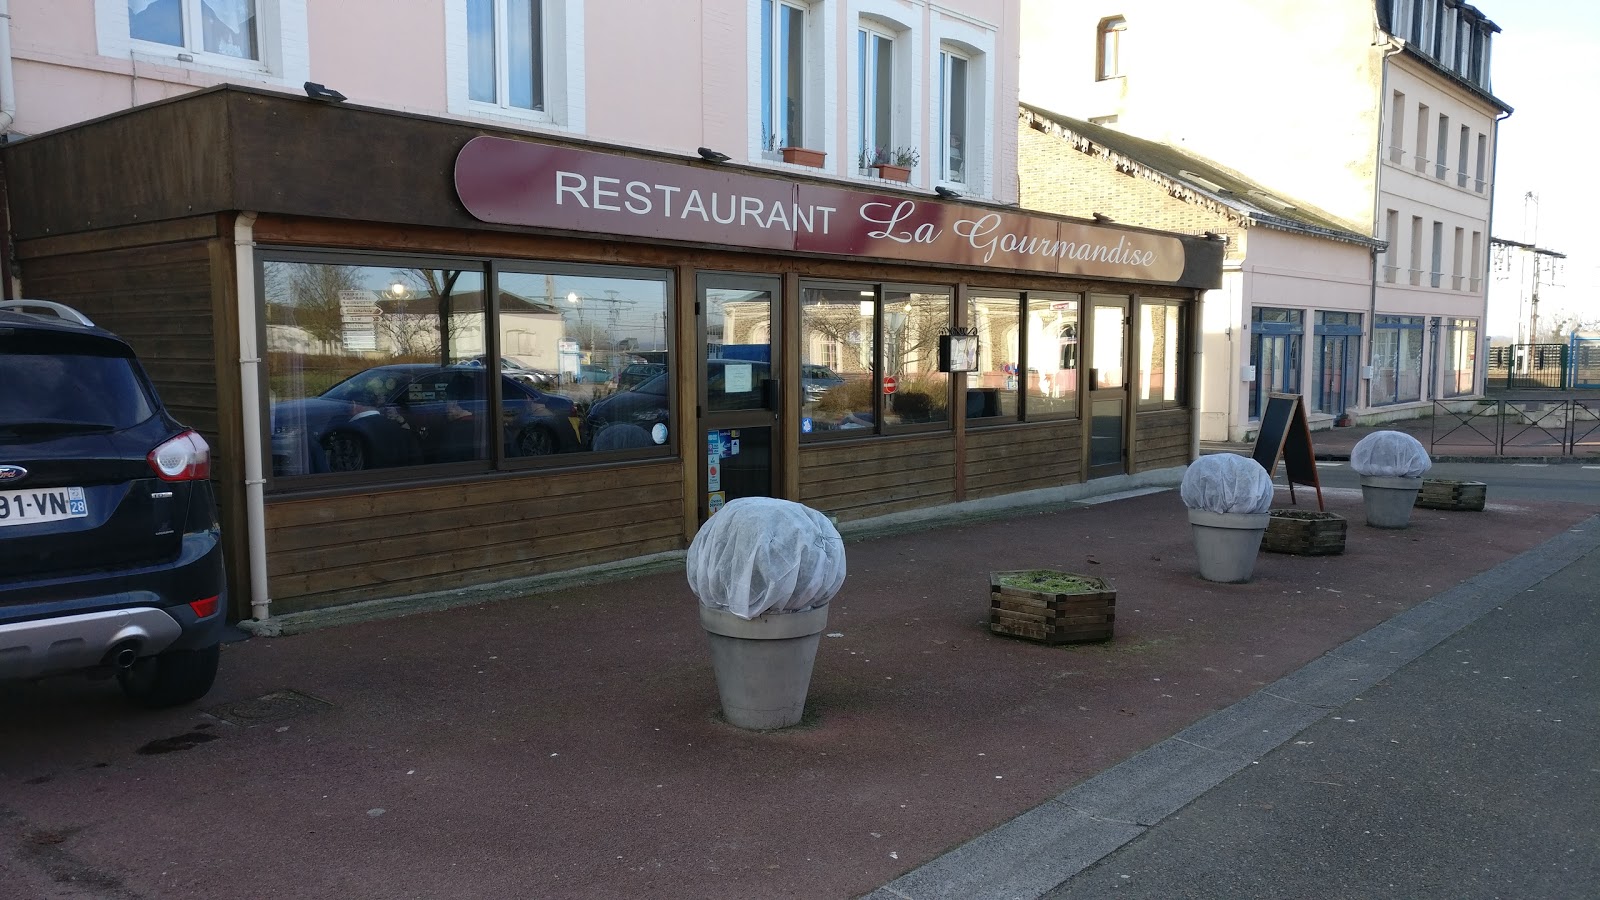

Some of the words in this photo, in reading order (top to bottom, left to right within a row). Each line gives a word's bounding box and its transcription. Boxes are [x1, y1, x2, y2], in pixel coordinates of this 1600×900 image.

[555, 170, 837, 234] RESTAURANT
[859, 200, 943, 244] La
[953, 213, 1158, 267] Gourmandise
[70, 501, 85, 513] 28
